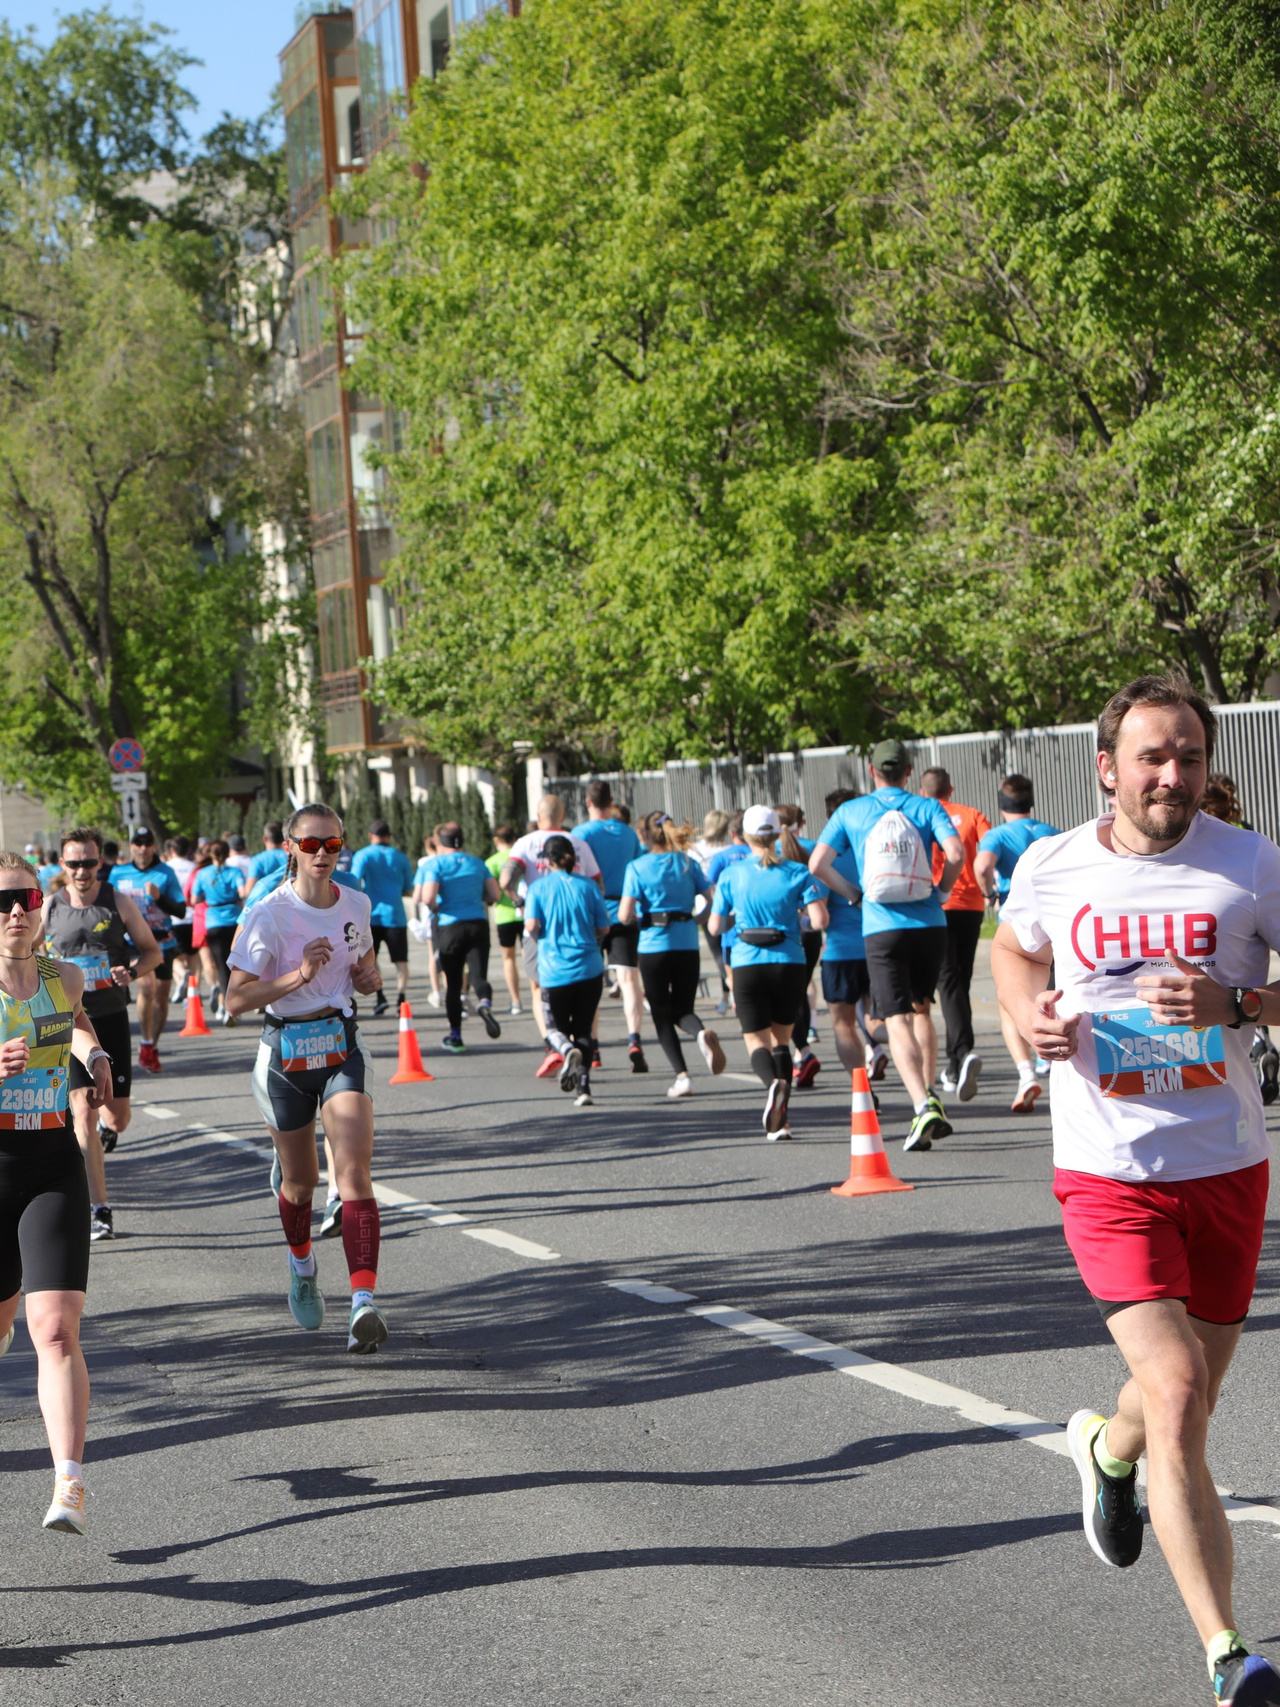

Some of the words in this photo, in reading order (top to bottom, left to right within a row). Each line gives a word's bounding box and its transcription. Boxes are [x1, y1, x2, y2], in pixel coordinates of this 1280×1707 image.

[1110, 1012, 1129, 1021] ПСБ
[295, 1034, 335, 1056] 21369
[1120, 1030, 1201, 1068] 25568
[1, 1087, 55, 1111] 23949
